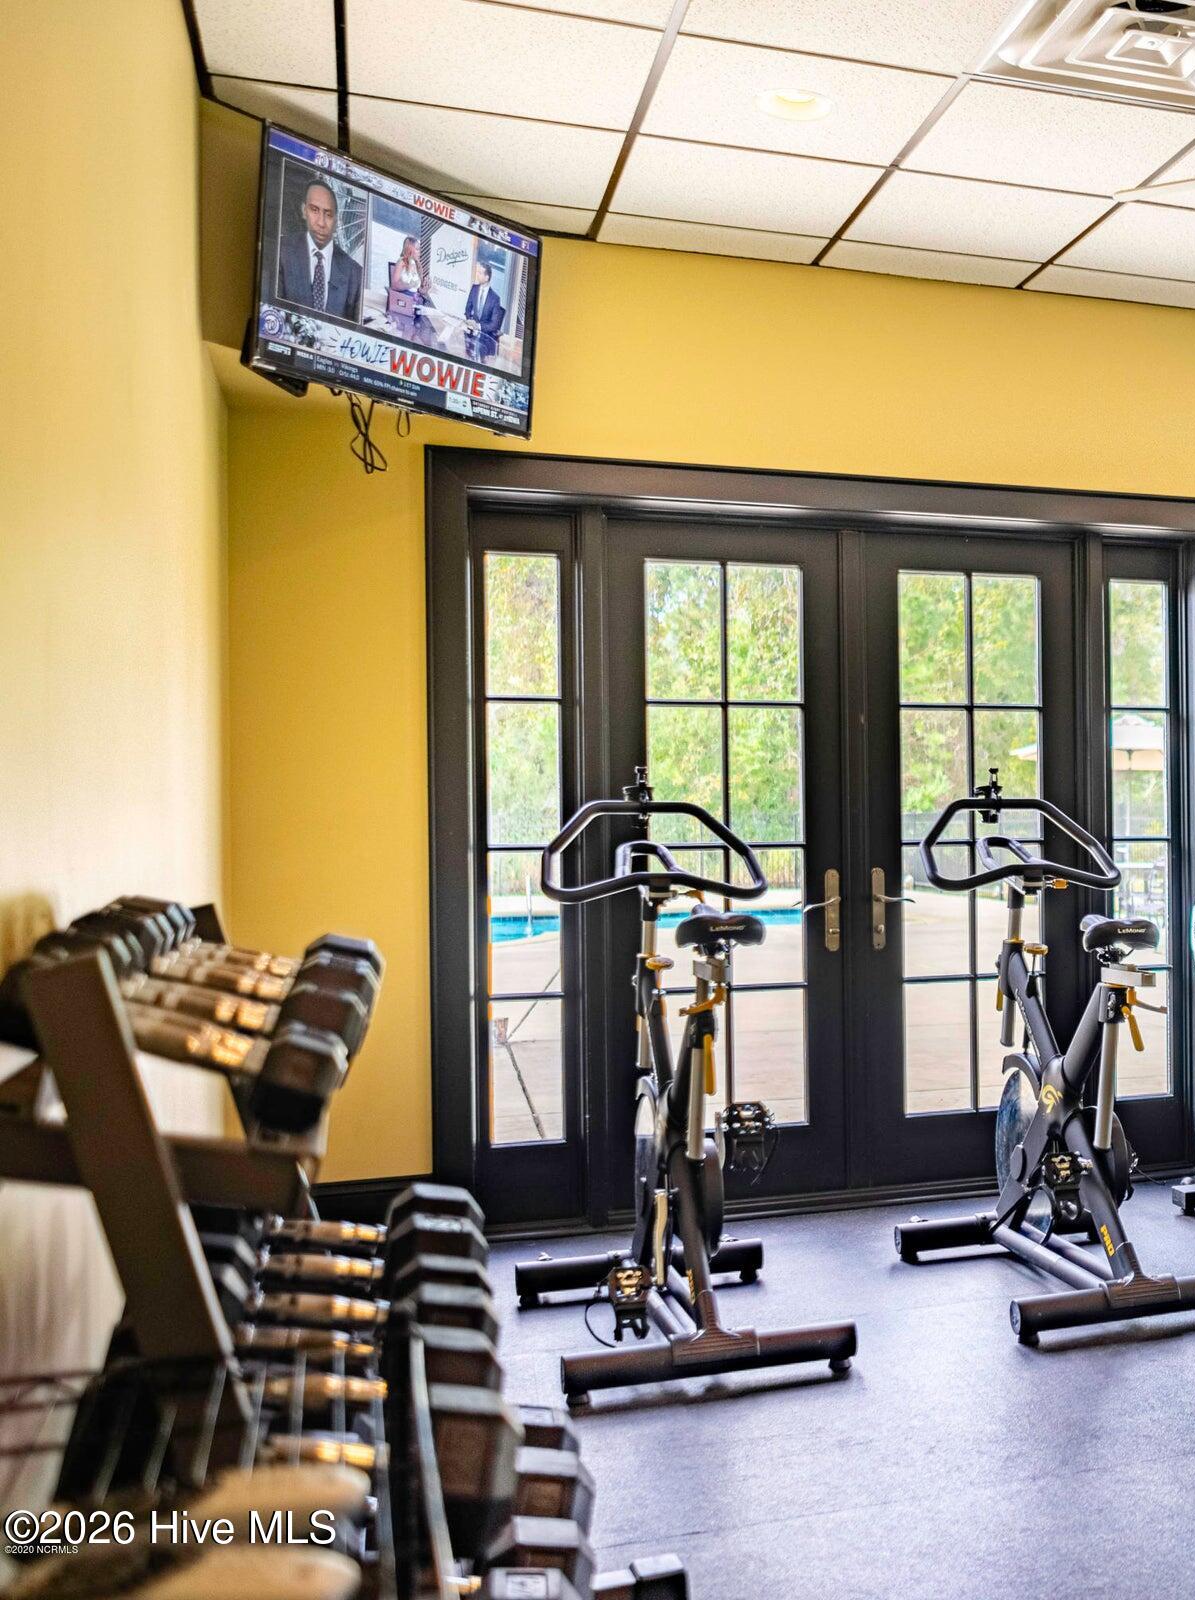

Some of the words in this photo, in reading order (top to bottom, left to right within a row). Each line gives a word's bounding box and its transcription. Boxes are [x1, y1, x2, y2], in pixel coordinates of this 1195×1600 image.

[413, 193, 456, 220] WOWIE
[340, 336, 391, 364] HOWIE
[389, 348, 487, 398] WOWIE
